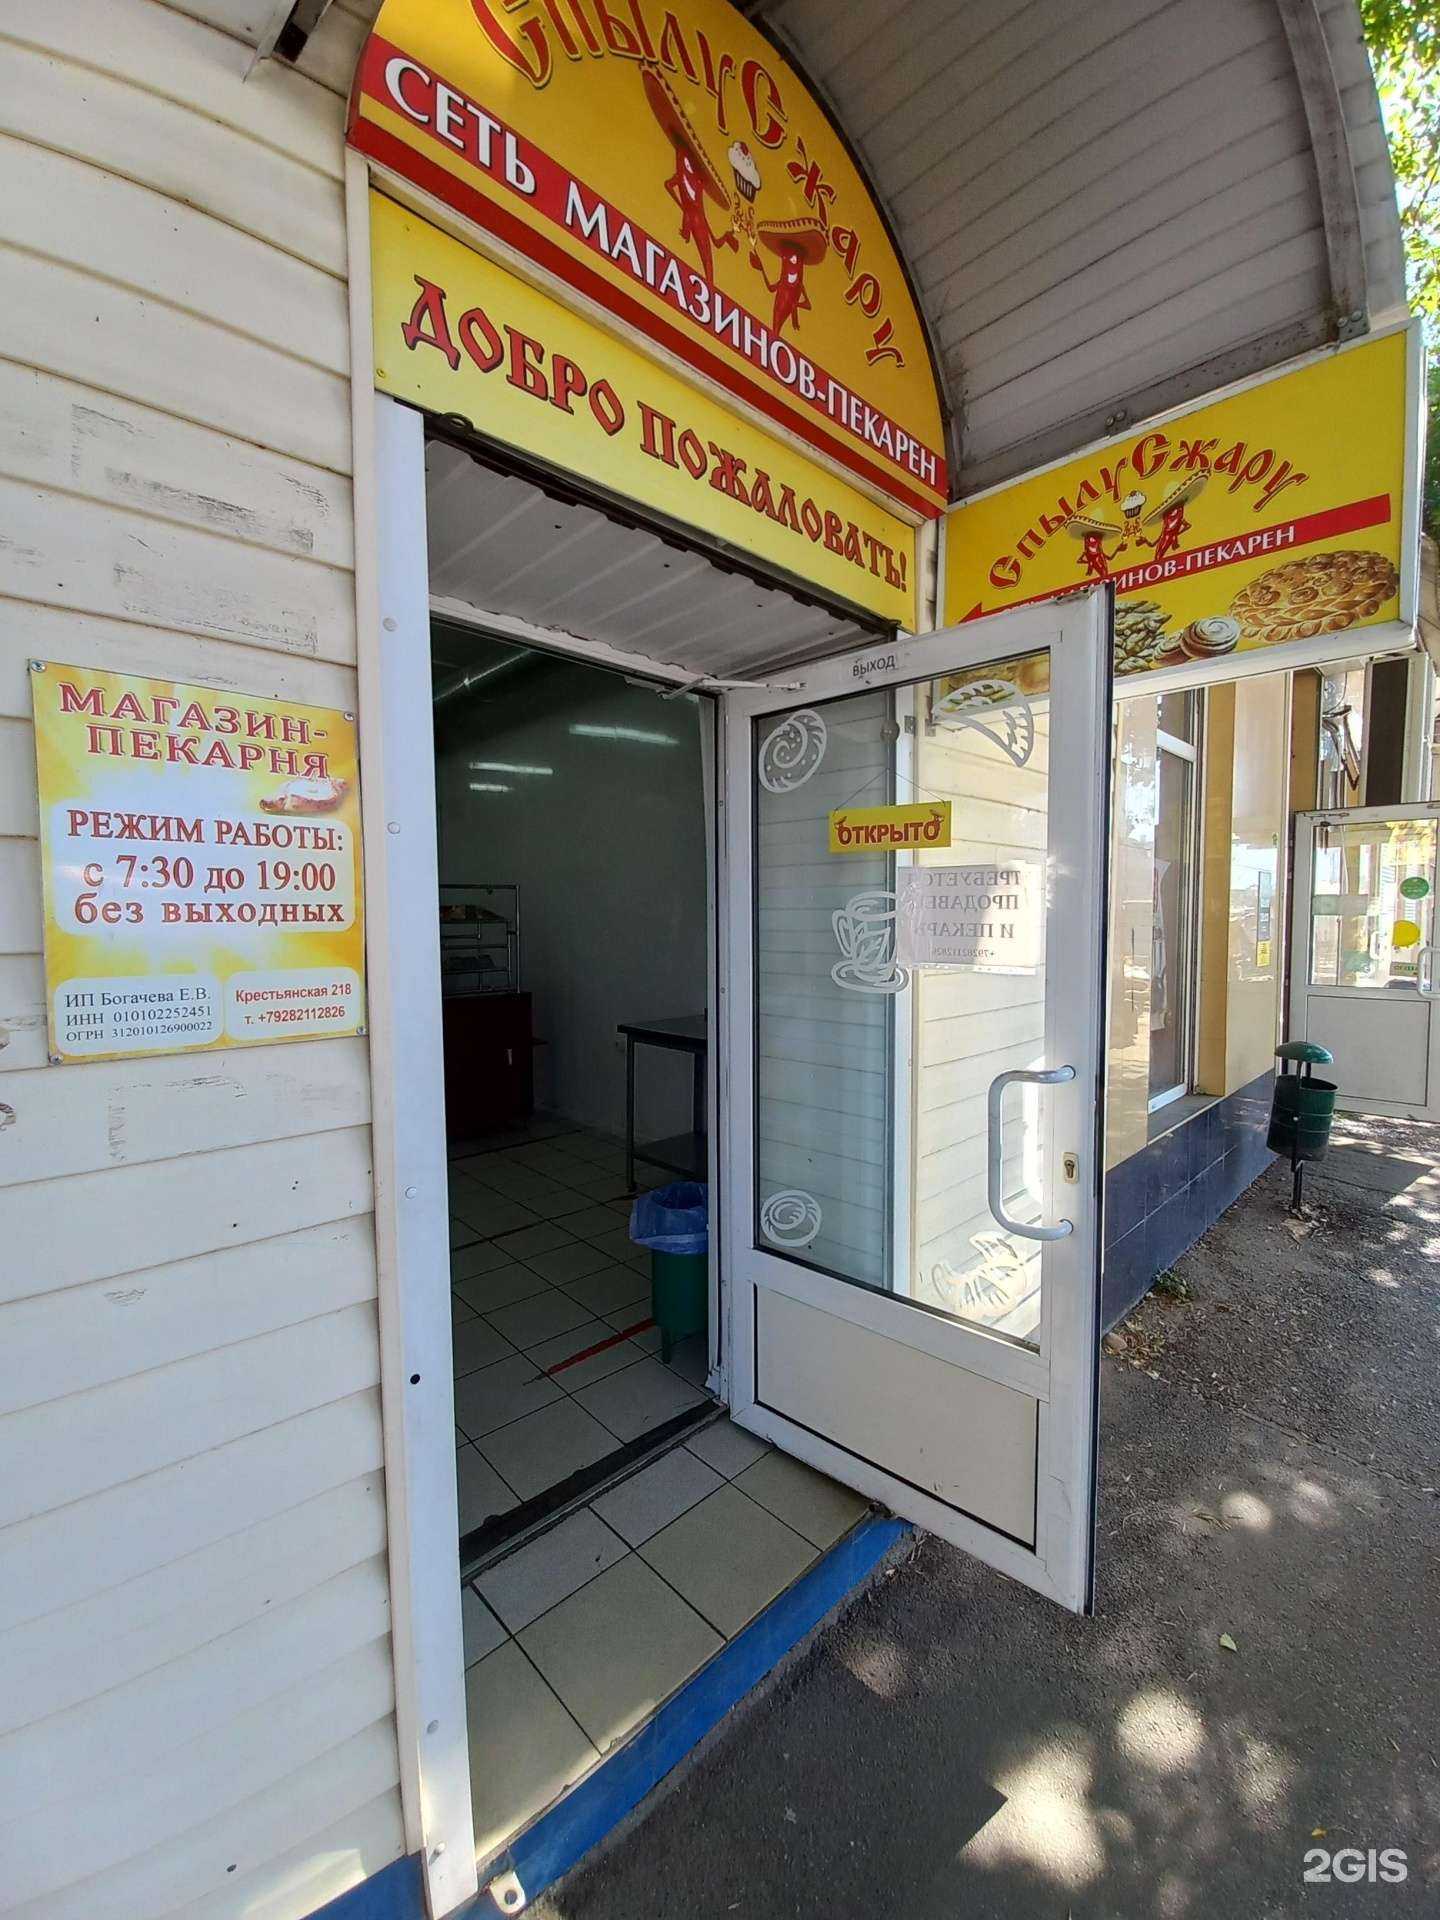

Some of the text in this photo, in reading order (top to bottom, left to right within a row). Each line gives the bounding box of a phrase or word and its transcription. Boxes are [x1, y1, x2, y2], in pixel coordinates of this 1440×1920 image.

[384, 57, 937, 487] СЕТЬ МАГАЗИНОВ-ПЕКАРЕН
[401, 274, 908, 593] ДОБРО ПОЖАЛОВАТЬ!
[59, 682, 328, 745] МАГАЗИН-
[86, 724, 330, 780] ПЕКАРНЯ
[66, 809, 344, 852] РЕЖИМ РАБОТЫ:
[836, 819, 941, 846] ОТКРЫТО
[116, 854, 195, 889] 7:30
[203, 866, 245, 894] до
[257, 861, 337, 892] 19:00
[74, 891, 345, 927] без выходных
[64, 993, 95, 1008] ИП
[101, 990, 174, 1007] Богачева
[235, 983, 352, 1005] Крестьянская 218
[66, 1006, 212, 1027] ИНН 010102252451
[66, 1021, 213, 1042] ОГРН 312010126900022
[258, 1005, 346, 1024] +79282112826
